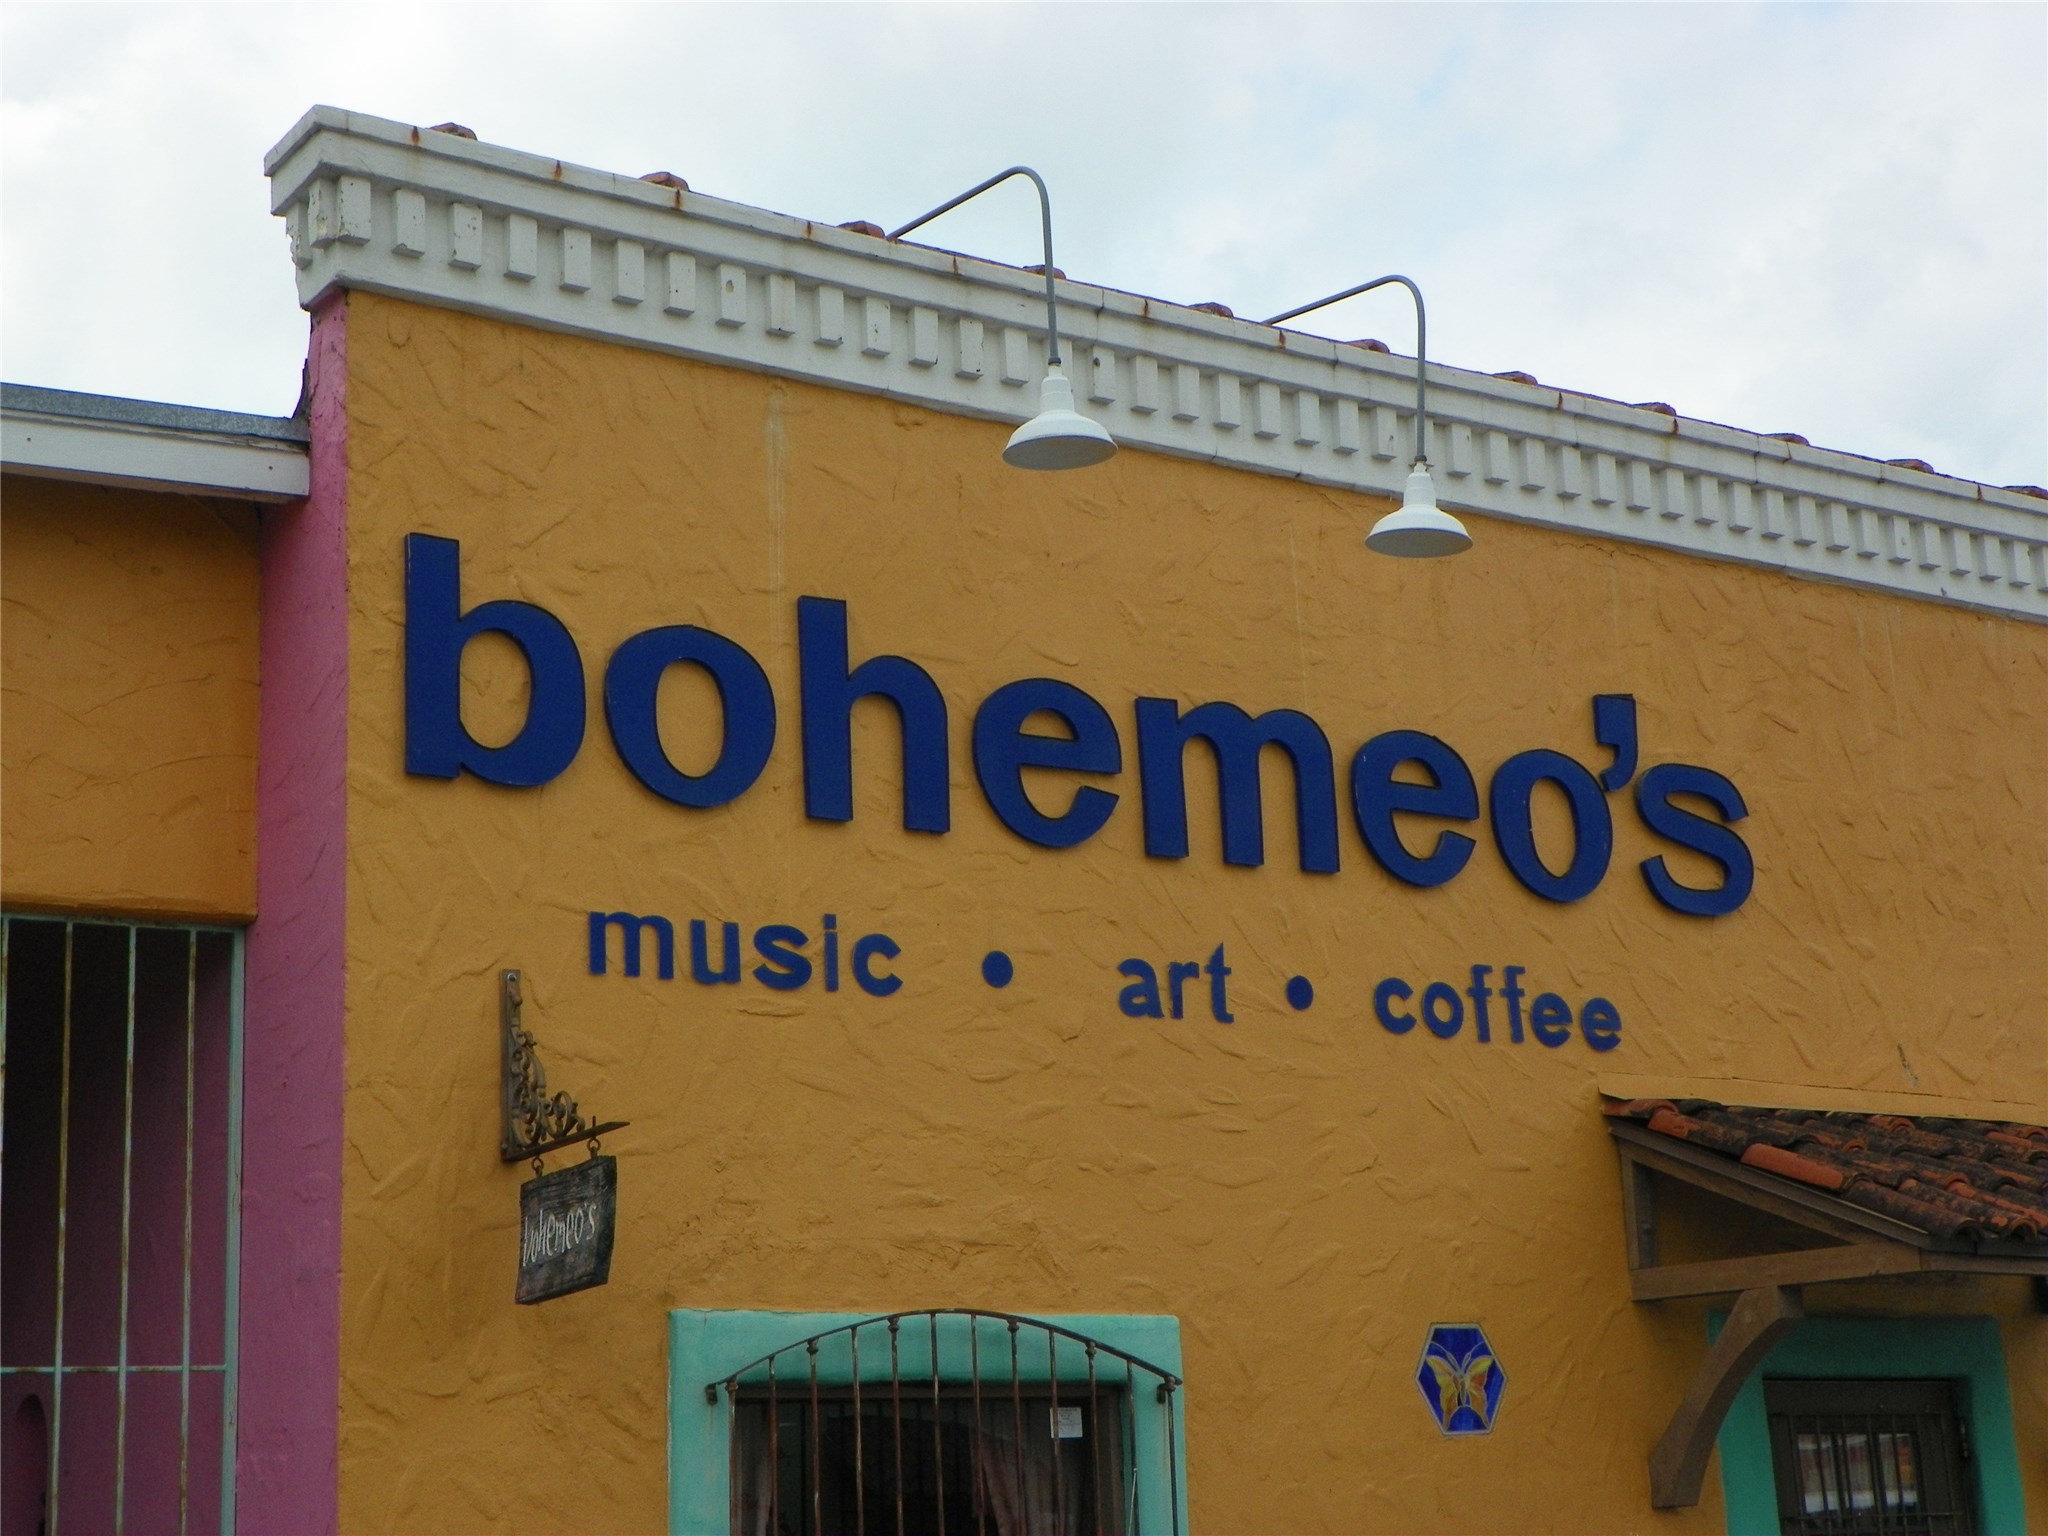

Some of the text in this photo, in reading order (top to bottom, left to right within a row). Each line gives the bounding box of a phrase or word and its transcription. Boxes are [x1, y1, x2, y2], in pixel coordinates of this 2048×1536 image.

[405, 533, 1753, 918] bohemeo's
[589, 911, 1622, 1051] music art coffee
[522, 1201, 598, 1267] bohemeo's
